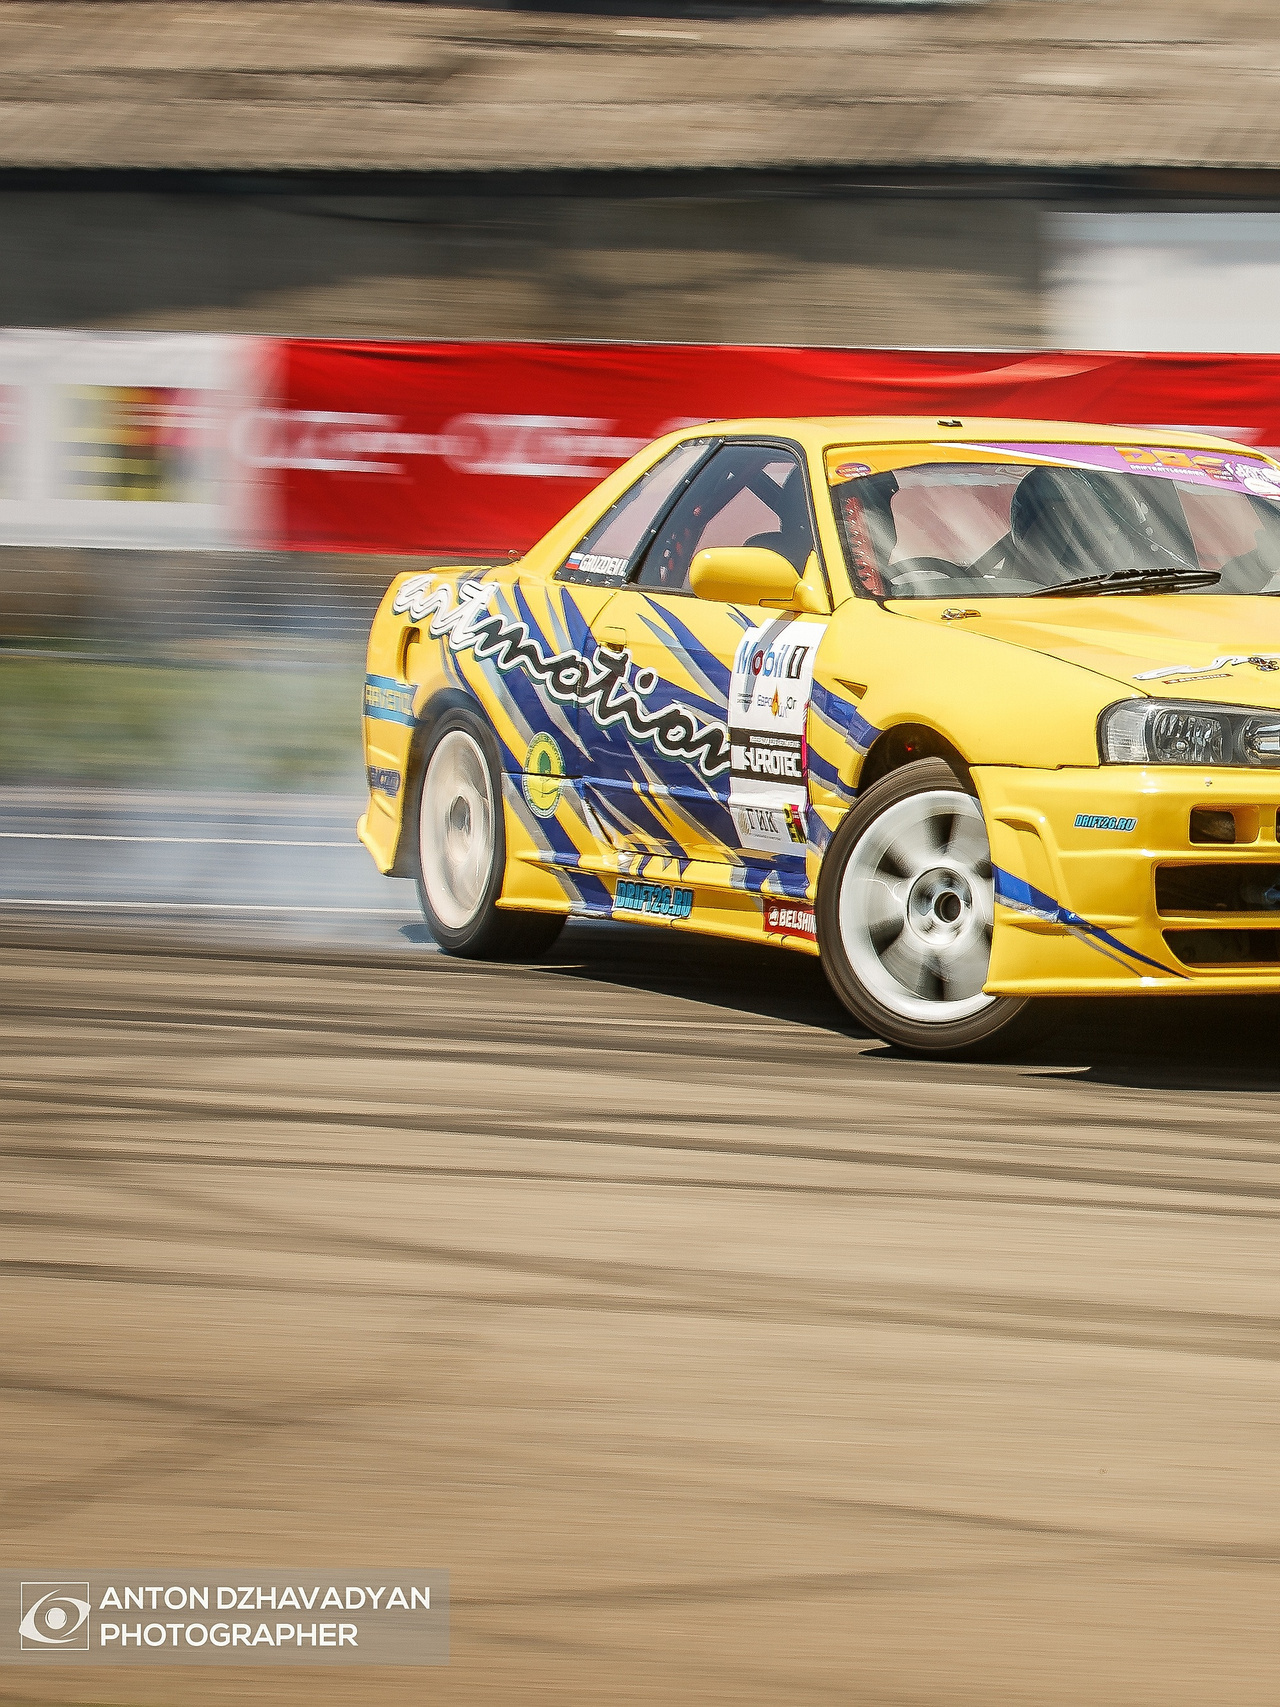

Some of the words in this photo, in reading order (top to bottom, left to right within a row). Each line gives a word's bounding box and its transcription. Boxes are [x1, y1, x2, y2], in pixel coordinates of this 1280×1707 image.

[736, 640, 791, 678] Mobil
[785, 645, 810, 680] 1
[1074, 814, 1137, 831] DRIFT26.RU
[615, 880, 694, 918] DRIFT26.RU
